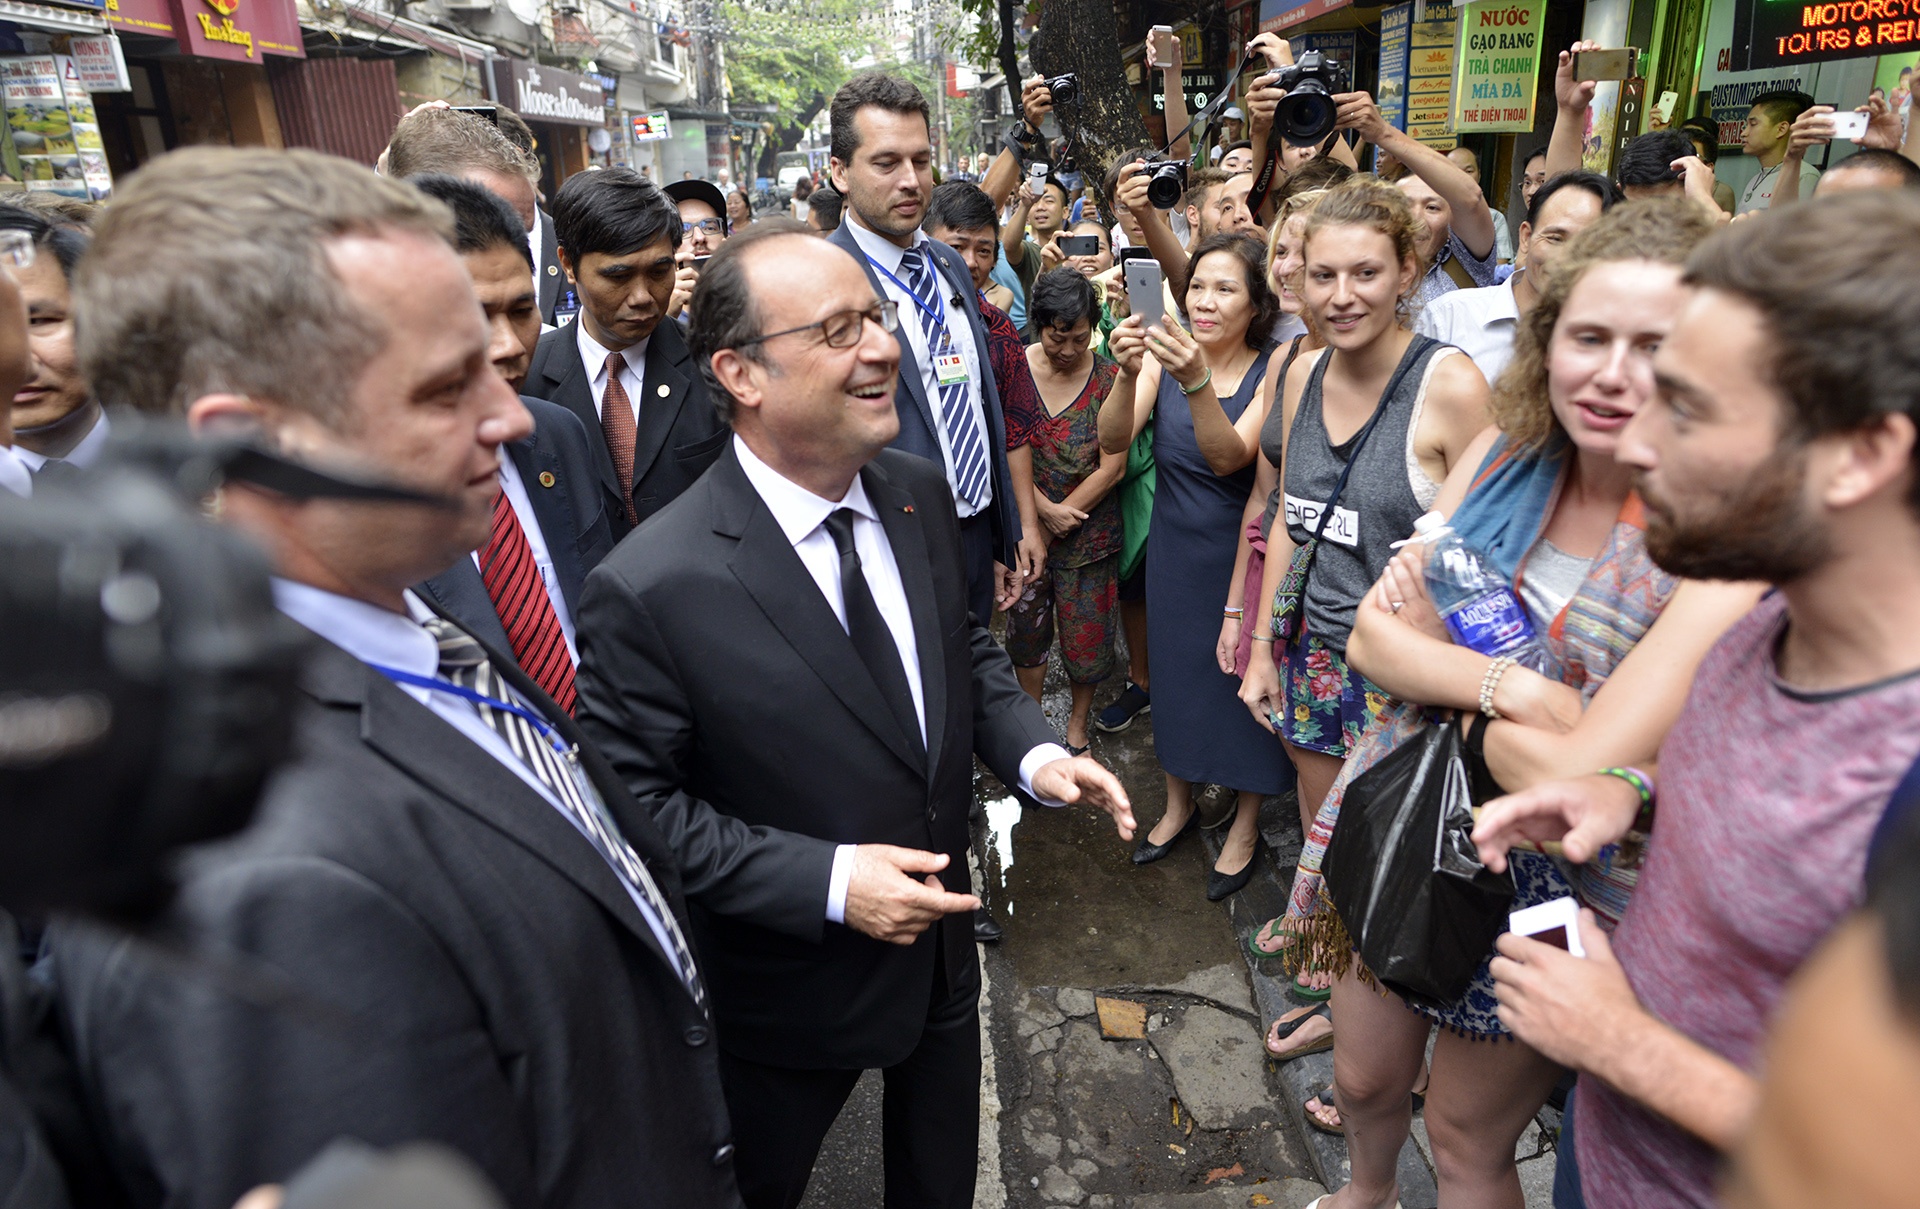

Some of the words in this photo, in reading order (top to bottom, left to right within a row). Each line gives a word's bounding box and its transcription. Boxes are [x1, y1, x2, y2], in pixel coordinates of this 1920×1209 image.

[1479, 5, 1530, 27] NƯỚC
[1470, 33, 1497, 54] GẠO
[1499, 32, 1535, 50] RANG
[1775, 28, 1851, 56] TOURS
[1855, 25, 1873, 47] &
[1414, 65, 1437, 73] Vietnam
[1468, 55, 1489, 75] TRÀ
[1492, 57, 1533, 75] CHANH
[1159, 75, 1193, 87] HOI
[1471, 78, 1499, 99] MÍA
[1501, 77, 1523, 98] ĐÁ
[1412, 112, 1443, 121] Jetstar
[1503, 108, 1528, 124] THOẠI
[1256, 159, 1274, 193] Canon
[1286, 501, 1319, 524] RIP
